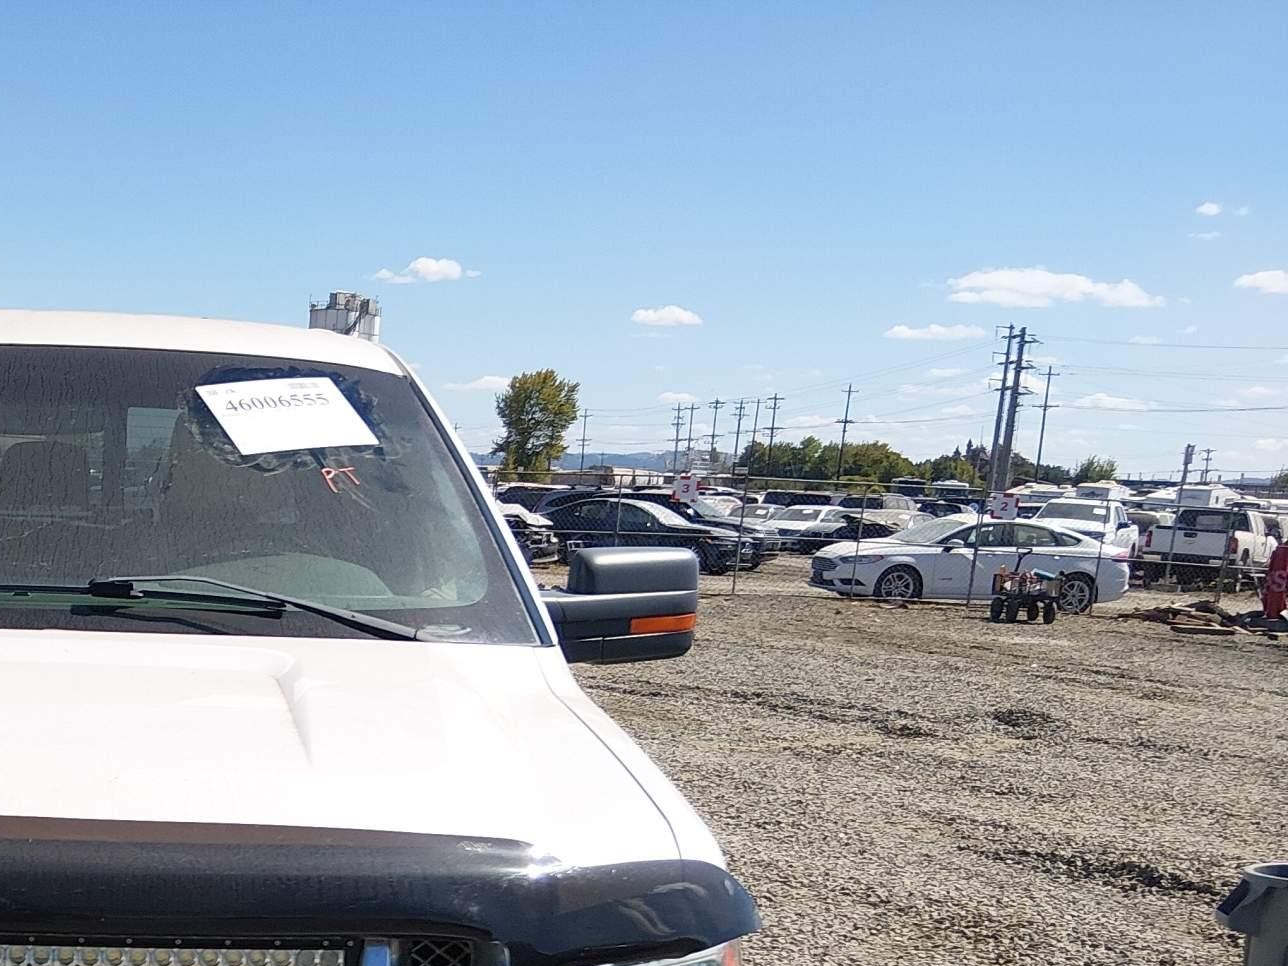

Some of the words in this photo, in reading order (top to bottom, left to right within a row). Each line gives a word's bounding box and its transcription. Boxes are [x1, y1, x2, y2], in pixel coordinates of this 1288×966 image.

[225, 393, 330, 412] 46006555
[681, 484, 690, 494] 3
[1000, 502, 1009, 511] 2
